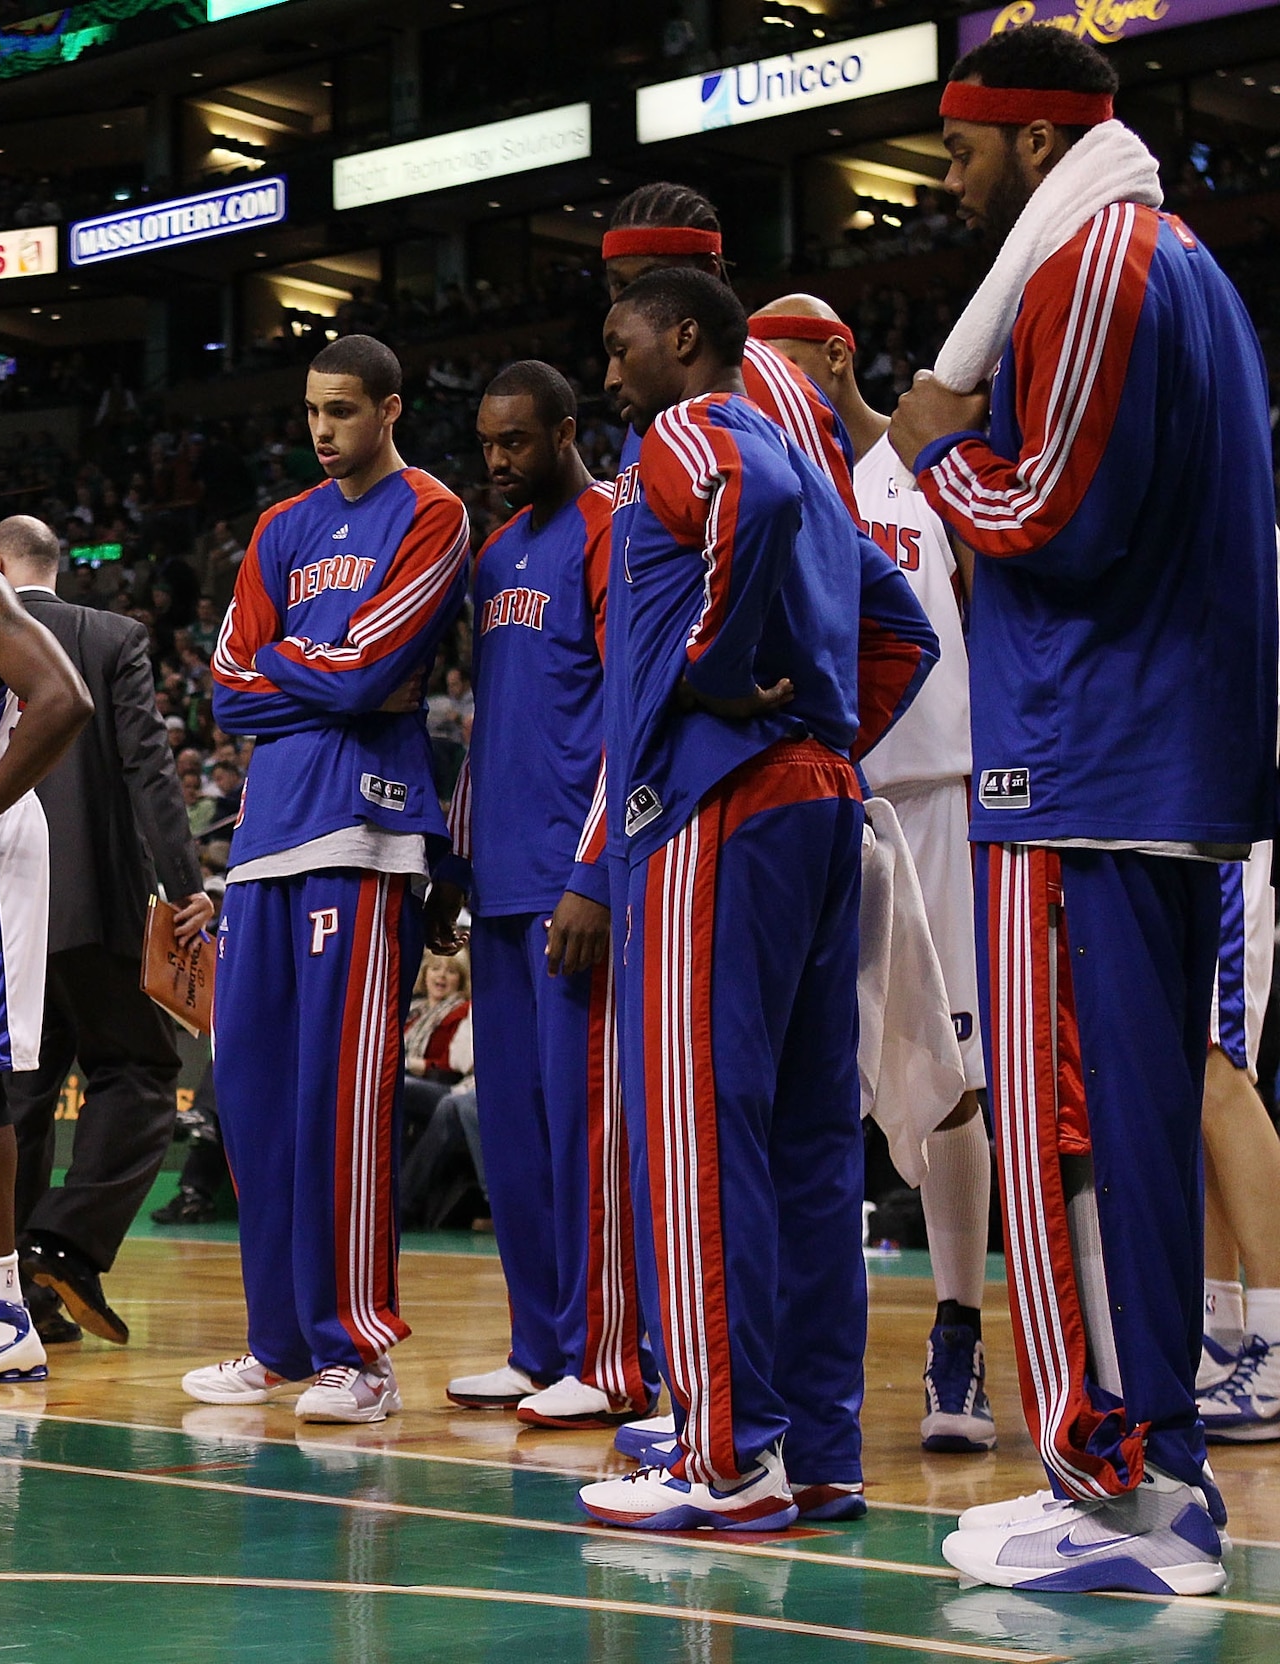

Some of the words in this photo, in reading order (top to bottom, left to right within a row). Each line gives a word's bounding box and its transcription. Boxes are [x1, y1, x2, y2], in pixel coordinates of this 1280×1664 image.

[733, 54, 862, 105] Unicco
[78, 187, 278, 257] MASSLOTTERY.COM
[287, 554, 376, 610] DETROIT
[481, 587, 551, 636] DETROIT
